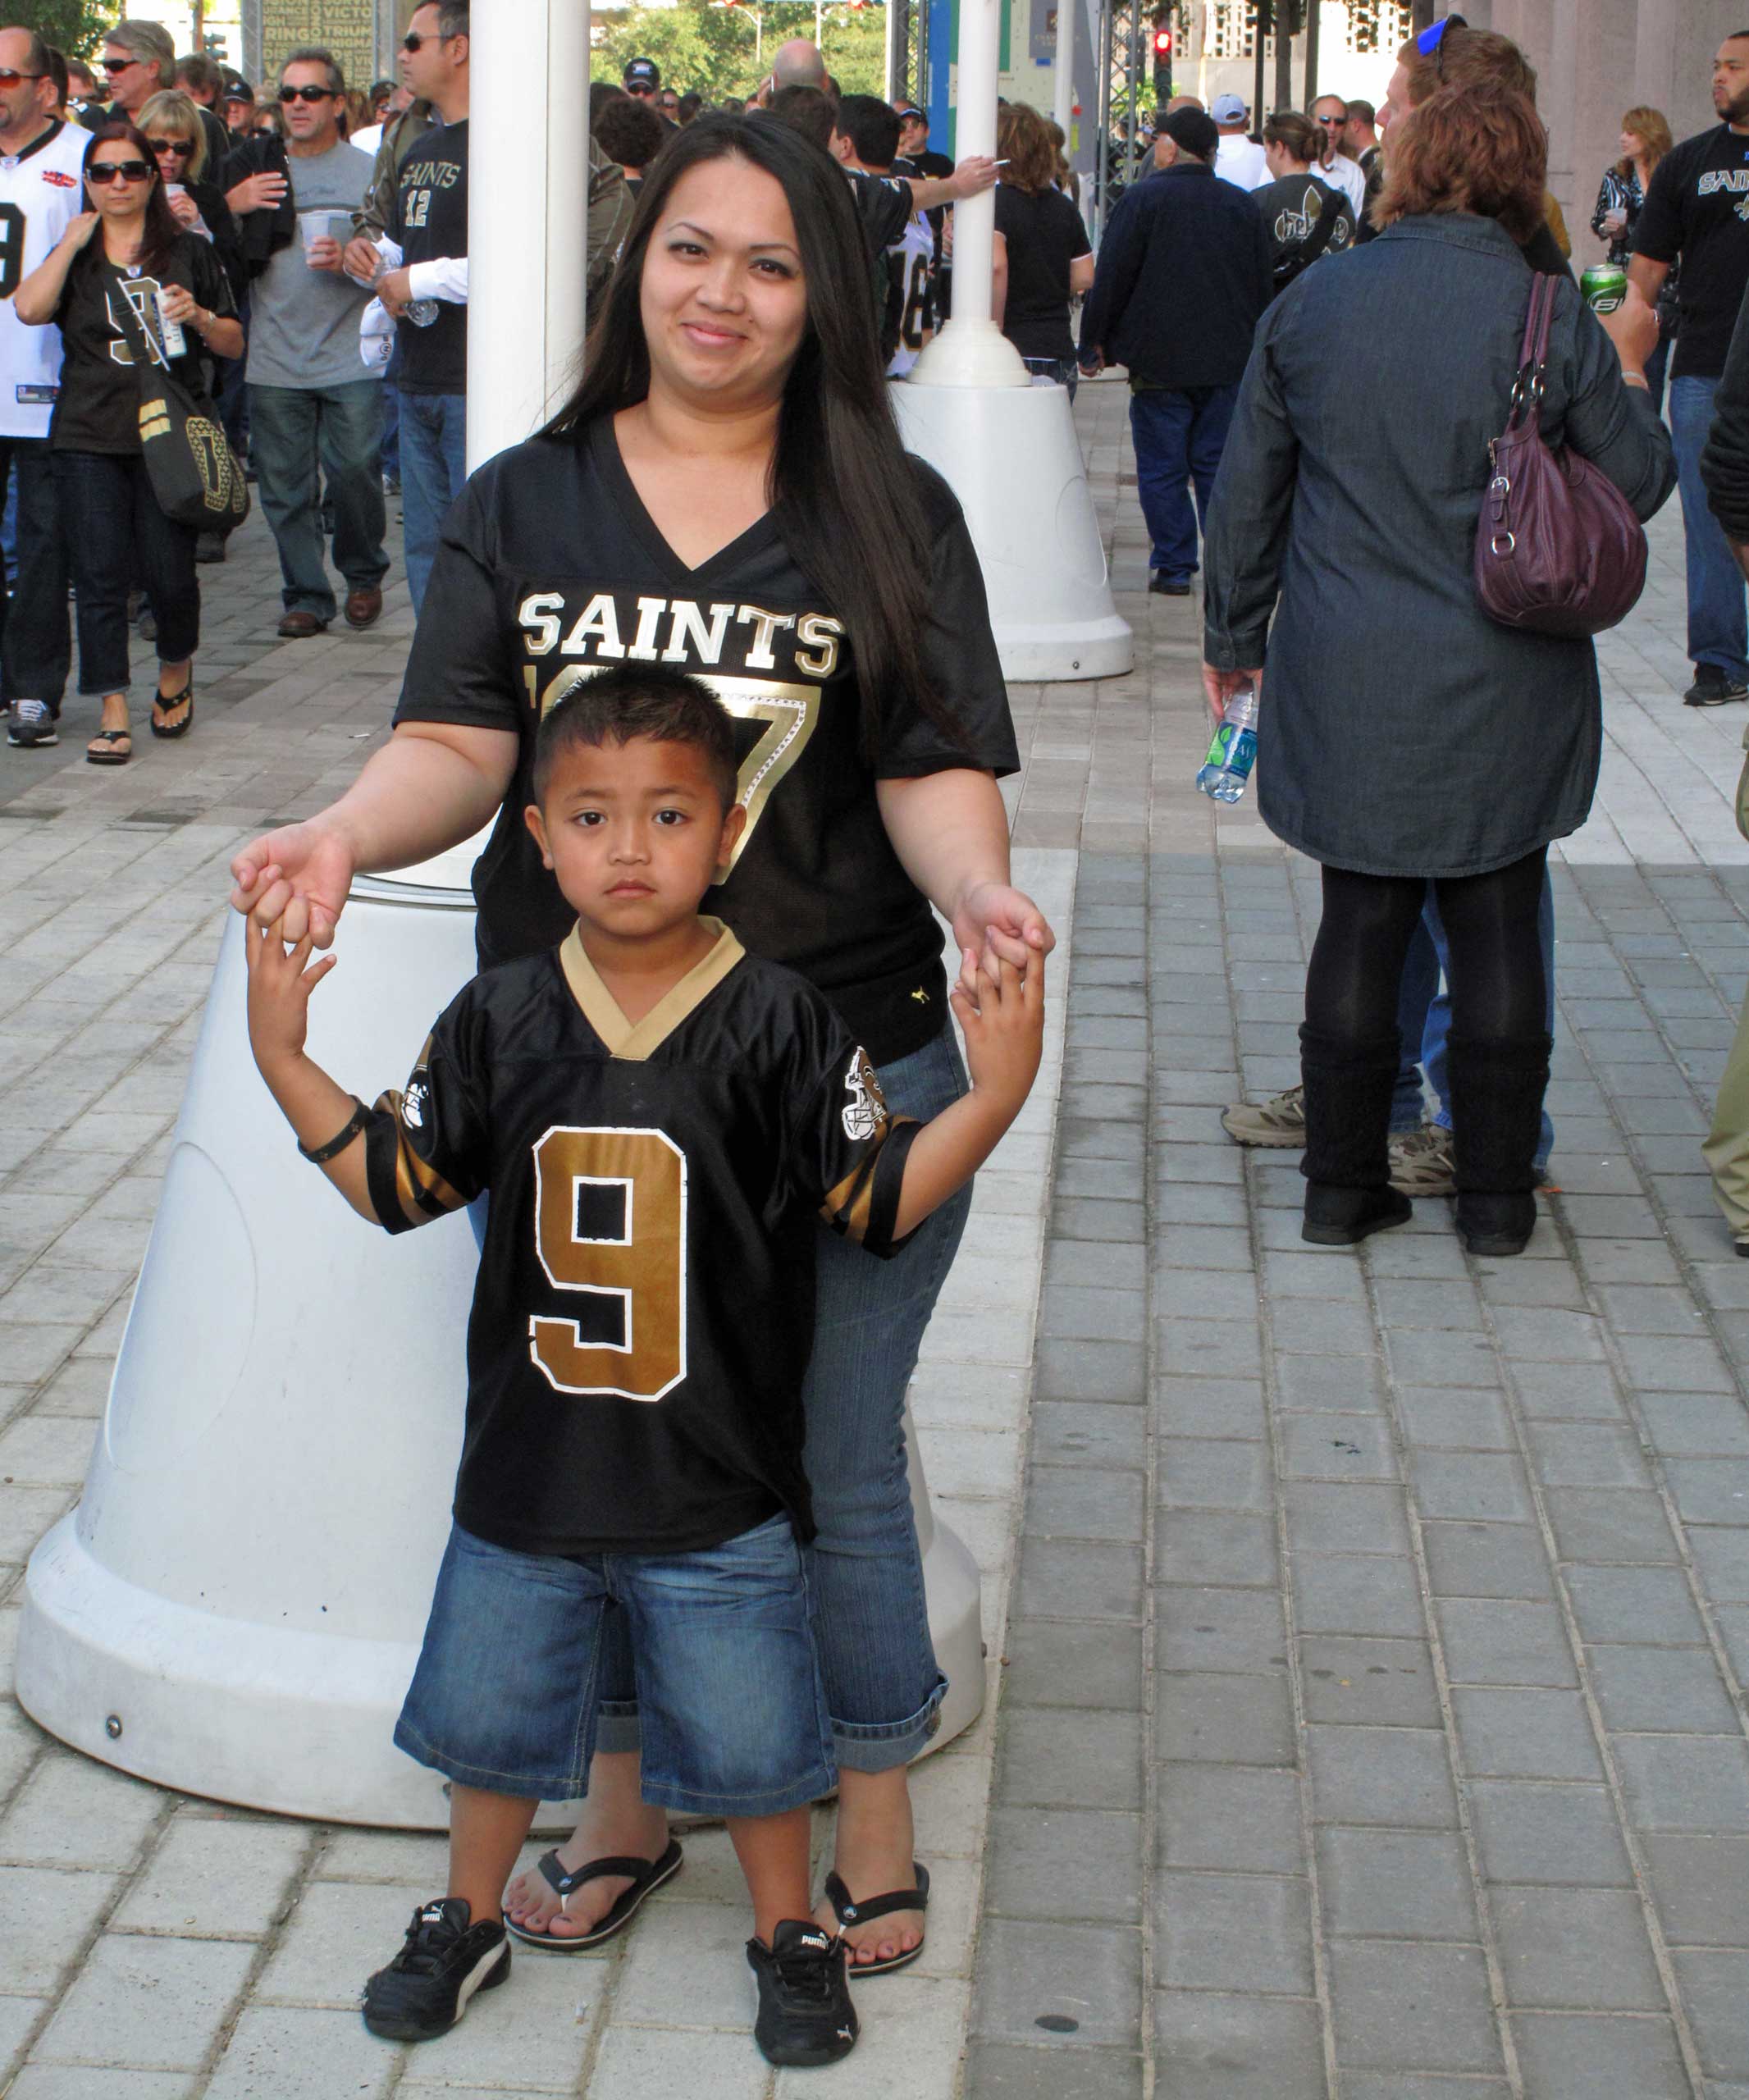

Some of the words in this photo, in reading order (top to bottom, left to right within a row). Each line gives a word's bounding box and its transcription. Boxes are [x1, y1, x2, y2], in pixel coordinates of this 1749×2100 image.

[405, 189, 432, 226] 12
[518, 591, 845, 679] SAINTS
[530, 1125, 687, 1401] 9
